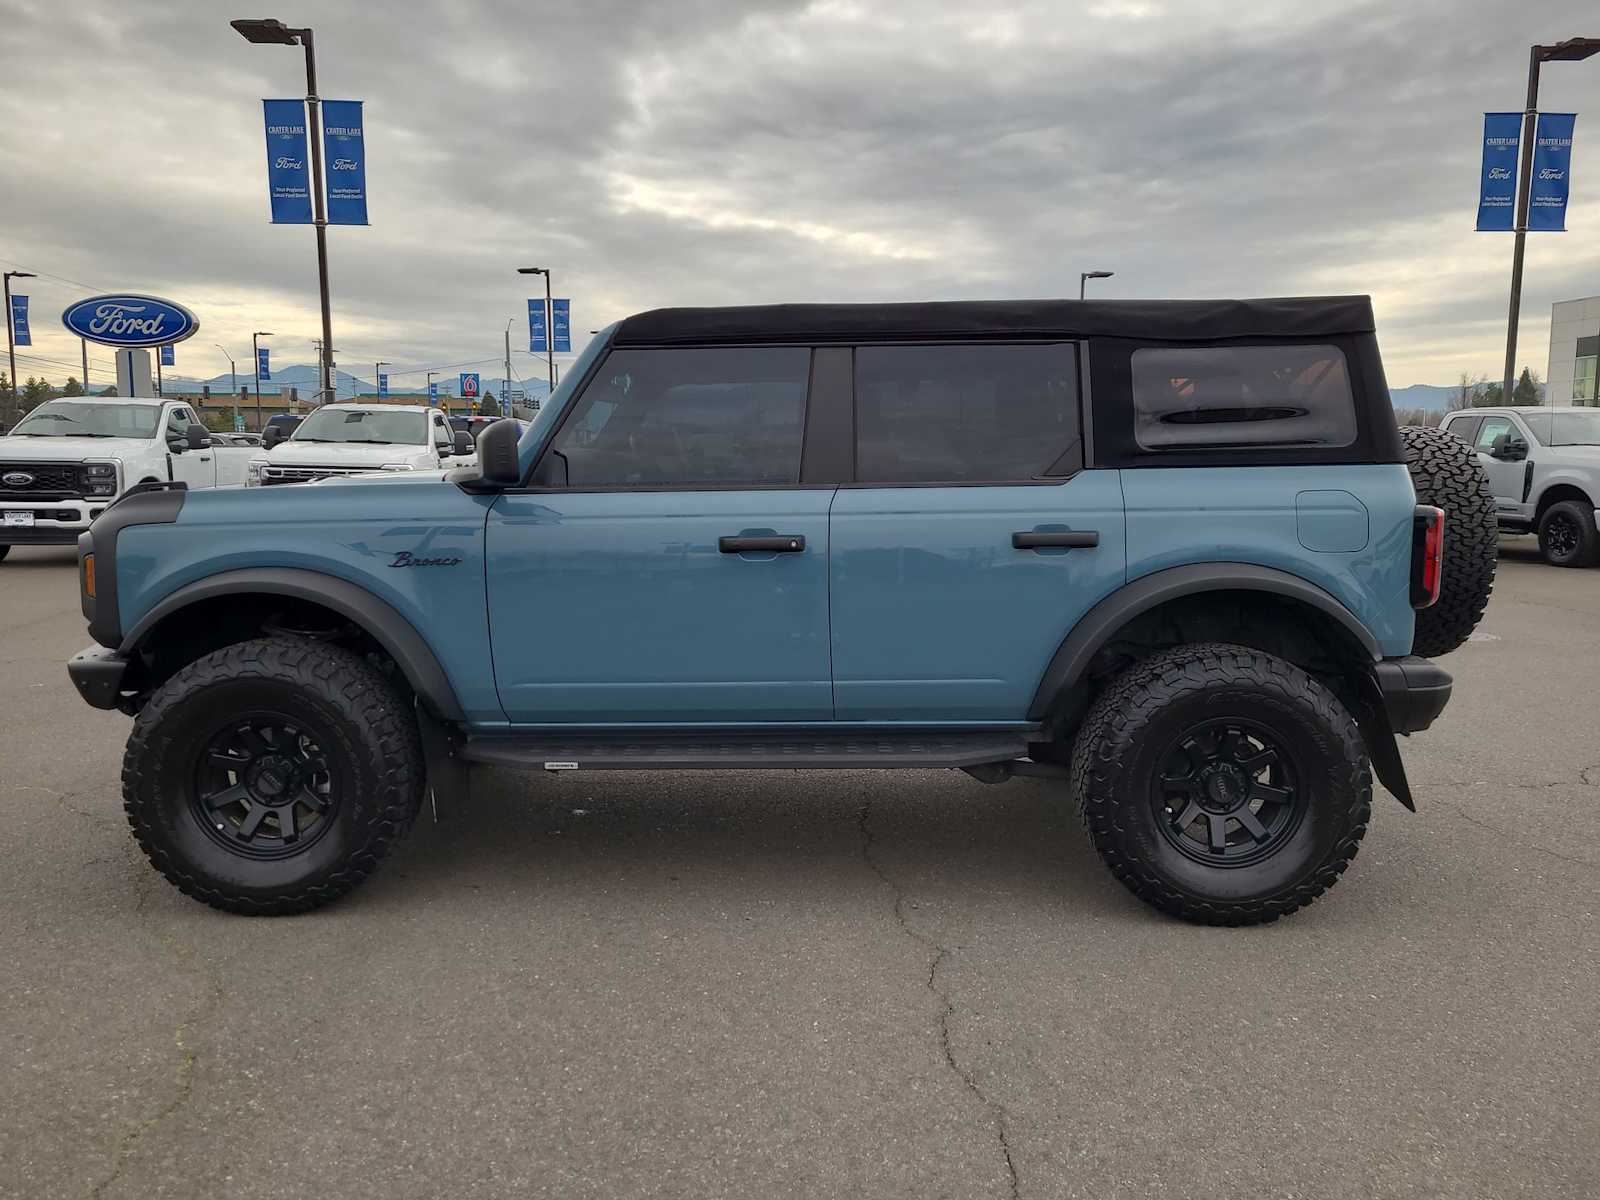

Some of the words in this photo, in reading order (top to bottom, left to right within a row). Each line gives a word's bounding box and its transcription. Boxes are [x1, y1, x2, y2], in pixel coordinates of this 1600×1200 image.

[268, 126, 289, 134] CRATER
[289, 126, 305, 134] LAKE
[326, 127, 346, 135] CRATER
[347, 128, 361, 136] LAKE
[275, 156, 302, 169] Ford
[332, 158, 358, 170] Ford
[1488, 167, 1512, 180] Ford
[1538, 168, 1565, 180] Ford
[89, 303, 165, 336] Ford
[464, 375, 477, 396] 6
[387, 551, 463, 568] Bronco
